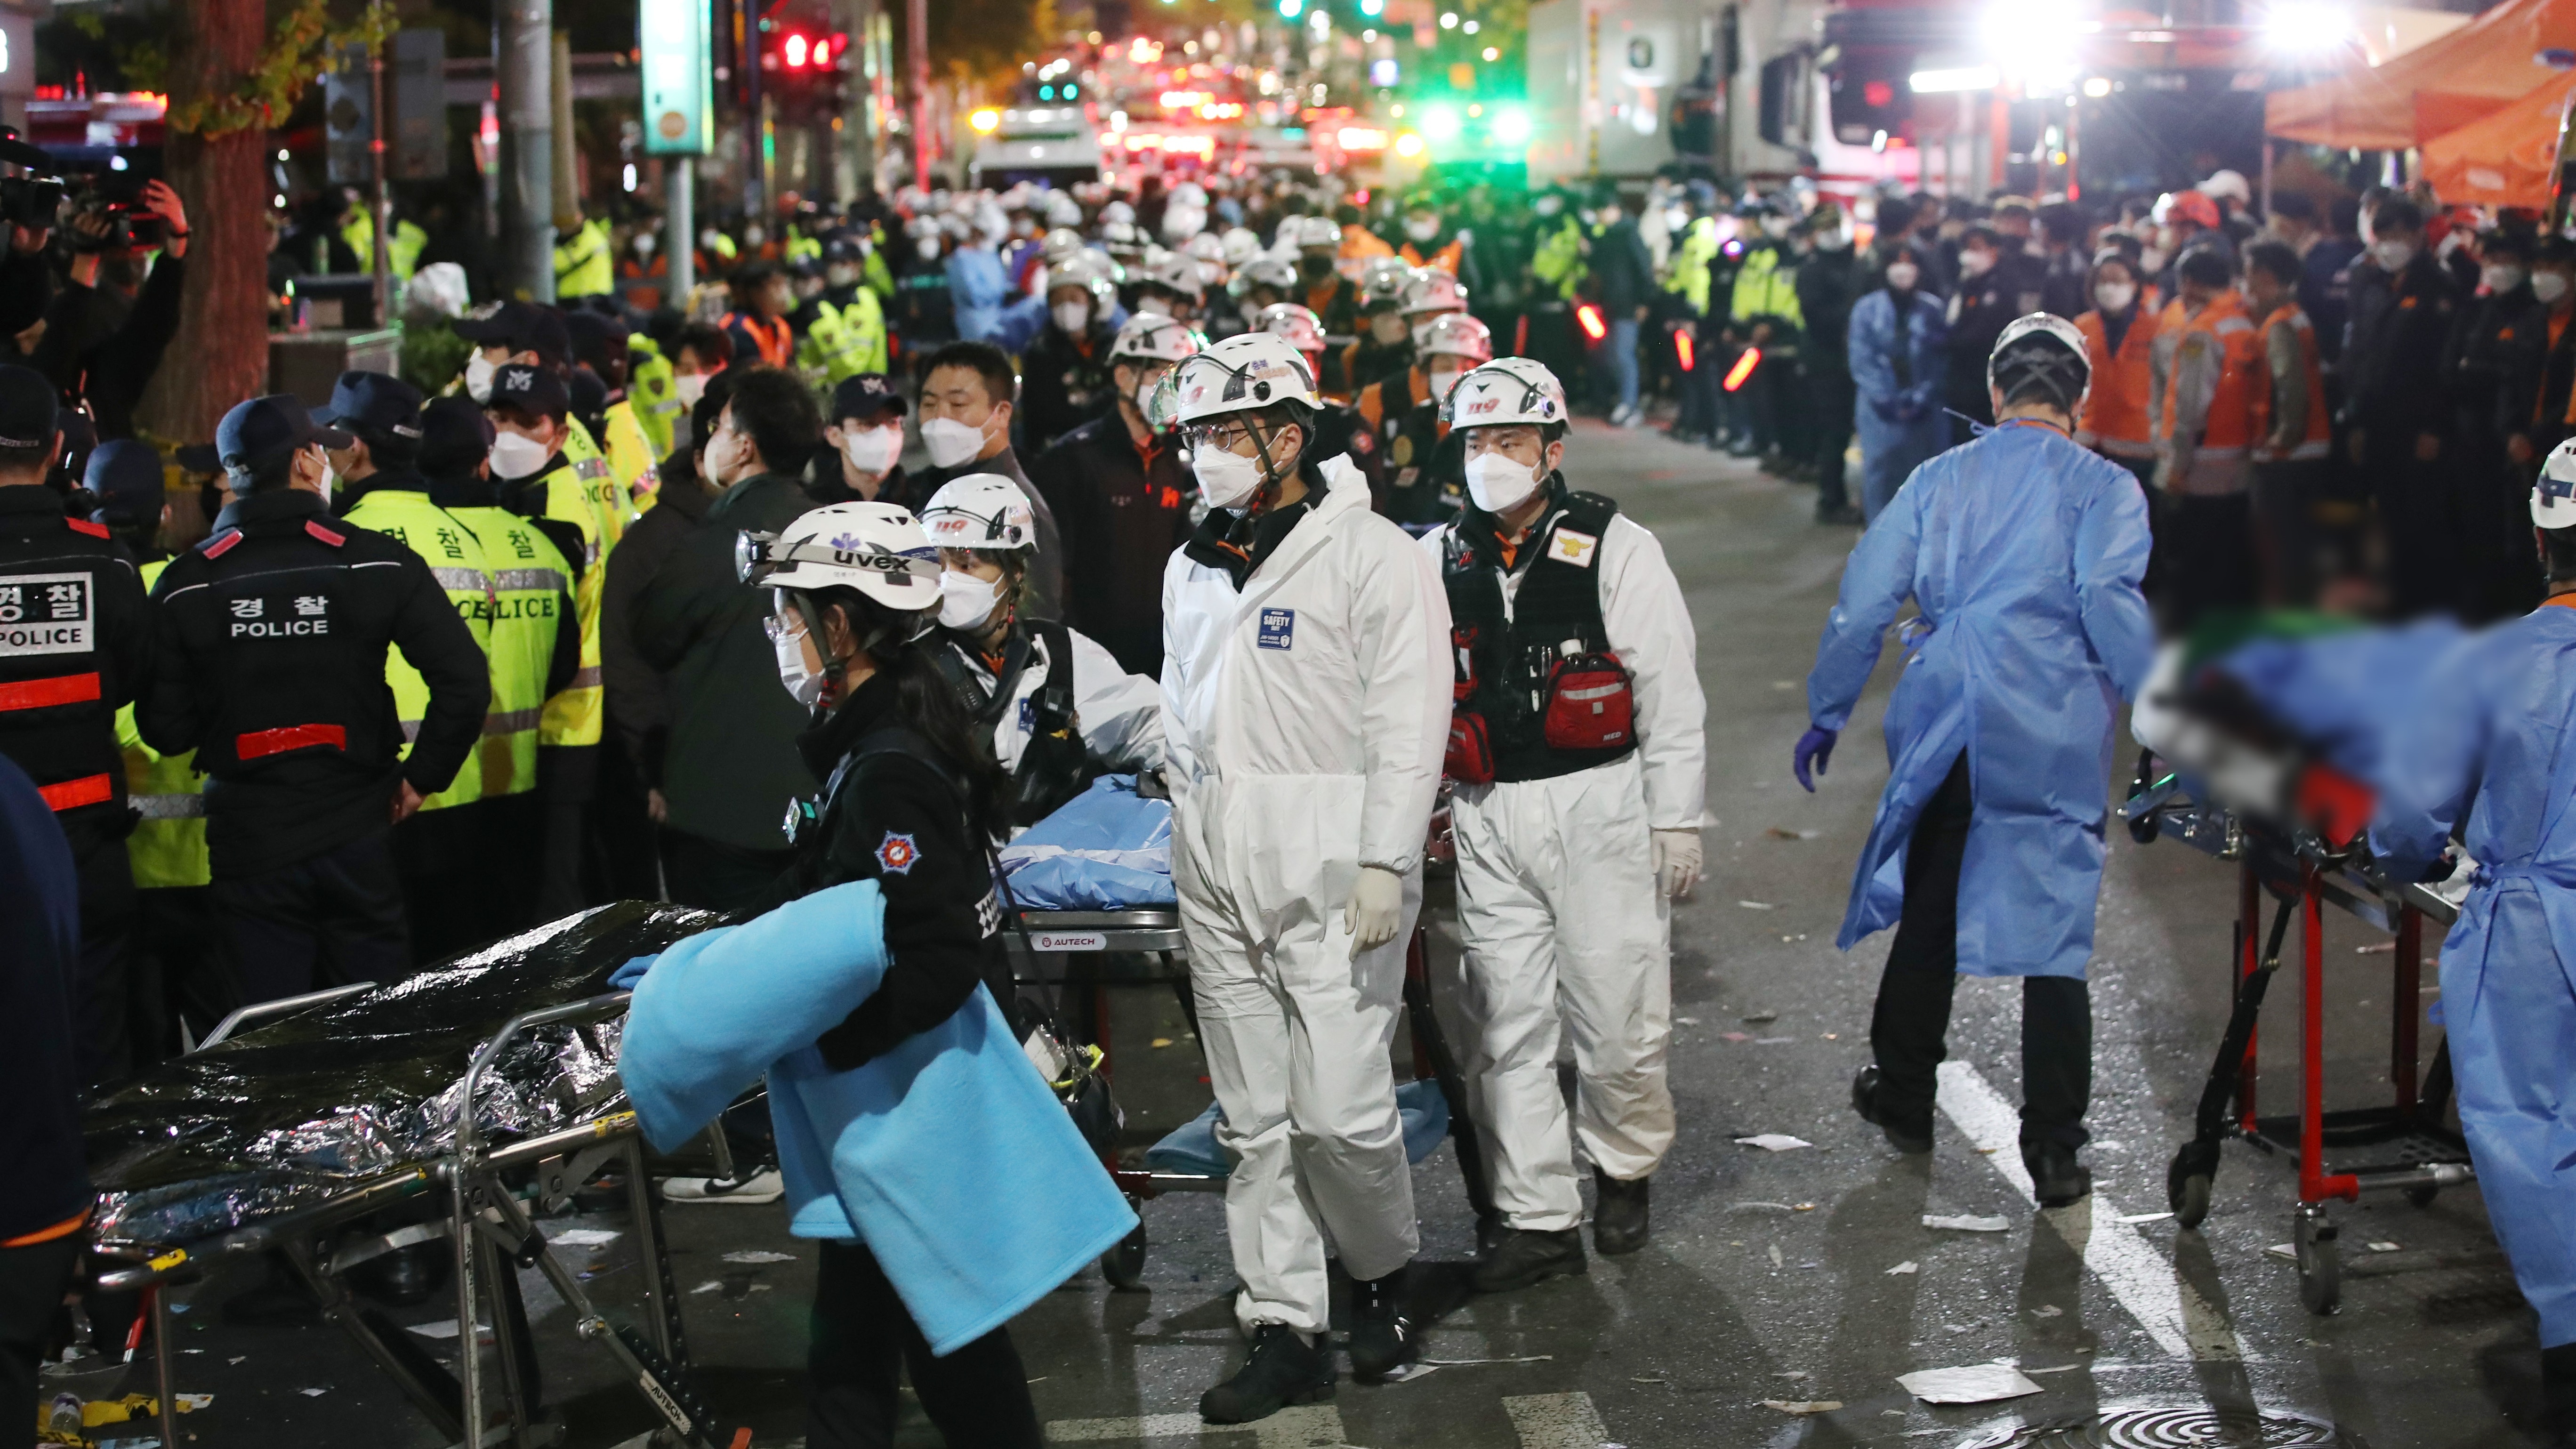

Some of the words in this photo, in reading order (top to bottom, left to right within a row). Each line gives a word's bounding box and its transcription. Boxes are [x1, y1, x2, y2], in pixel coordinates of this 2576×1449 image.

[1467, 398, 1500, 415] 119
[934, 520, 968, 533] 119
[834, 549, 911, 572] uvex
[231, 620, 328, 636] POLICE
[1264, 615, 1290, 627] SAFETY
[1603, 731, 1621, 741] MED
